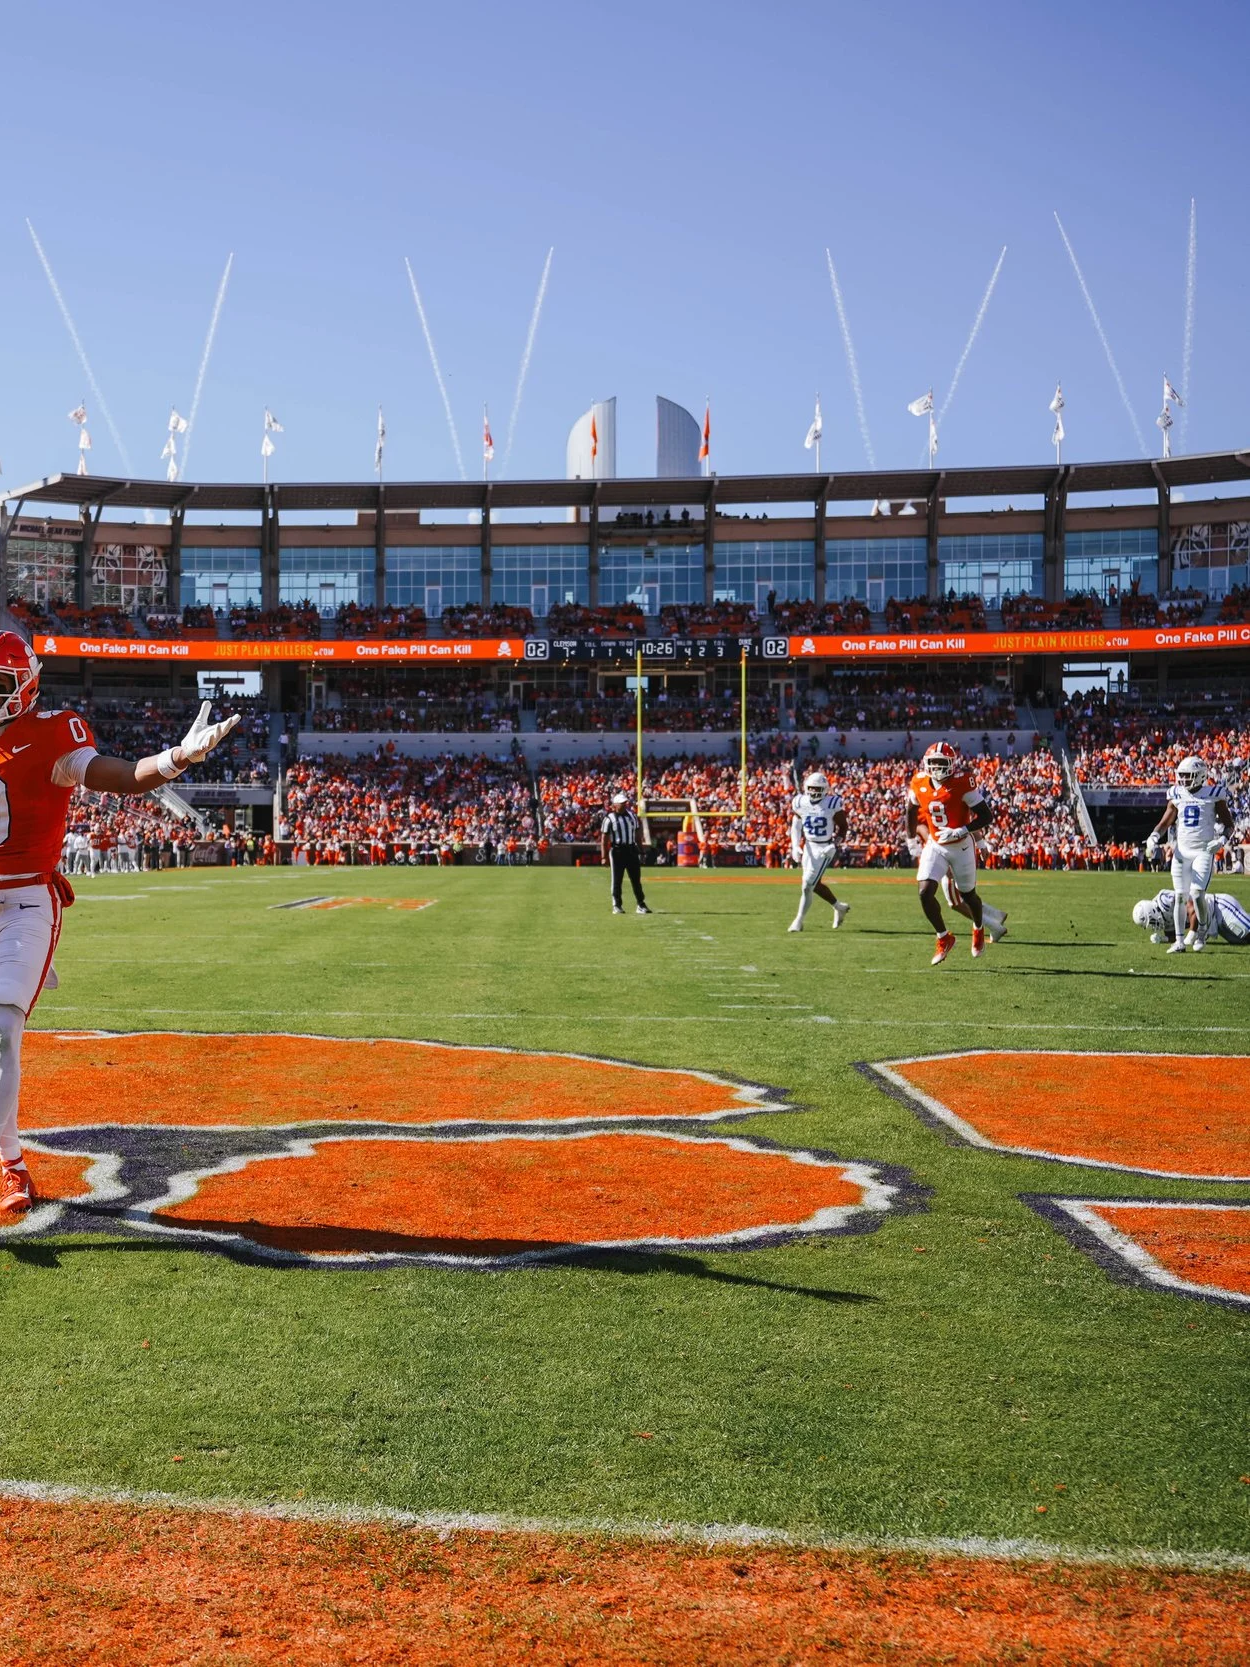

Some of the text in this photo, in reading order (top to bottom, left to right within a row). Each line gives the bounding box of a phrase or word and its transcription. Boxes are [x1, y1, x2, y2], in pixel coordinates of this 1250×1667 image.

[738, 638, 753, 646] DUKE
[993, 637, 1021, 649] JUST
[1024, 636, 1057, 648] PLAIN
[1155, 633, 1181, 644] One
[1184, 631, 1214, 643] Fake
[1217, 630, 1237, 641] Pill
[80, 642, 189, 655] One Fake Pill Can Kill
[214, 644, 239, 656] JUST
[241, 645, 272, 656] PLAIN
[356, 645, 472, 655] One Fake Pill Can Kill
[527, 643, 546, 656] 02
[626, 648, 633, 656] 4
[641, 642, 673, 655] 10:26
[684, 646, 691, 656] 4
[698, 647, 706, 657] 2
[717, 647, 724, 657] 3
[766, 641, 785, 655] 02
[842, 638, 966, 650] One Fake Pill Can Kill
[69, 717, 87, 743] 0
[928, 801, 948, 827] 8
[1184, 805, 1201, 827] 9
[804, 816, 828, 837] 42
